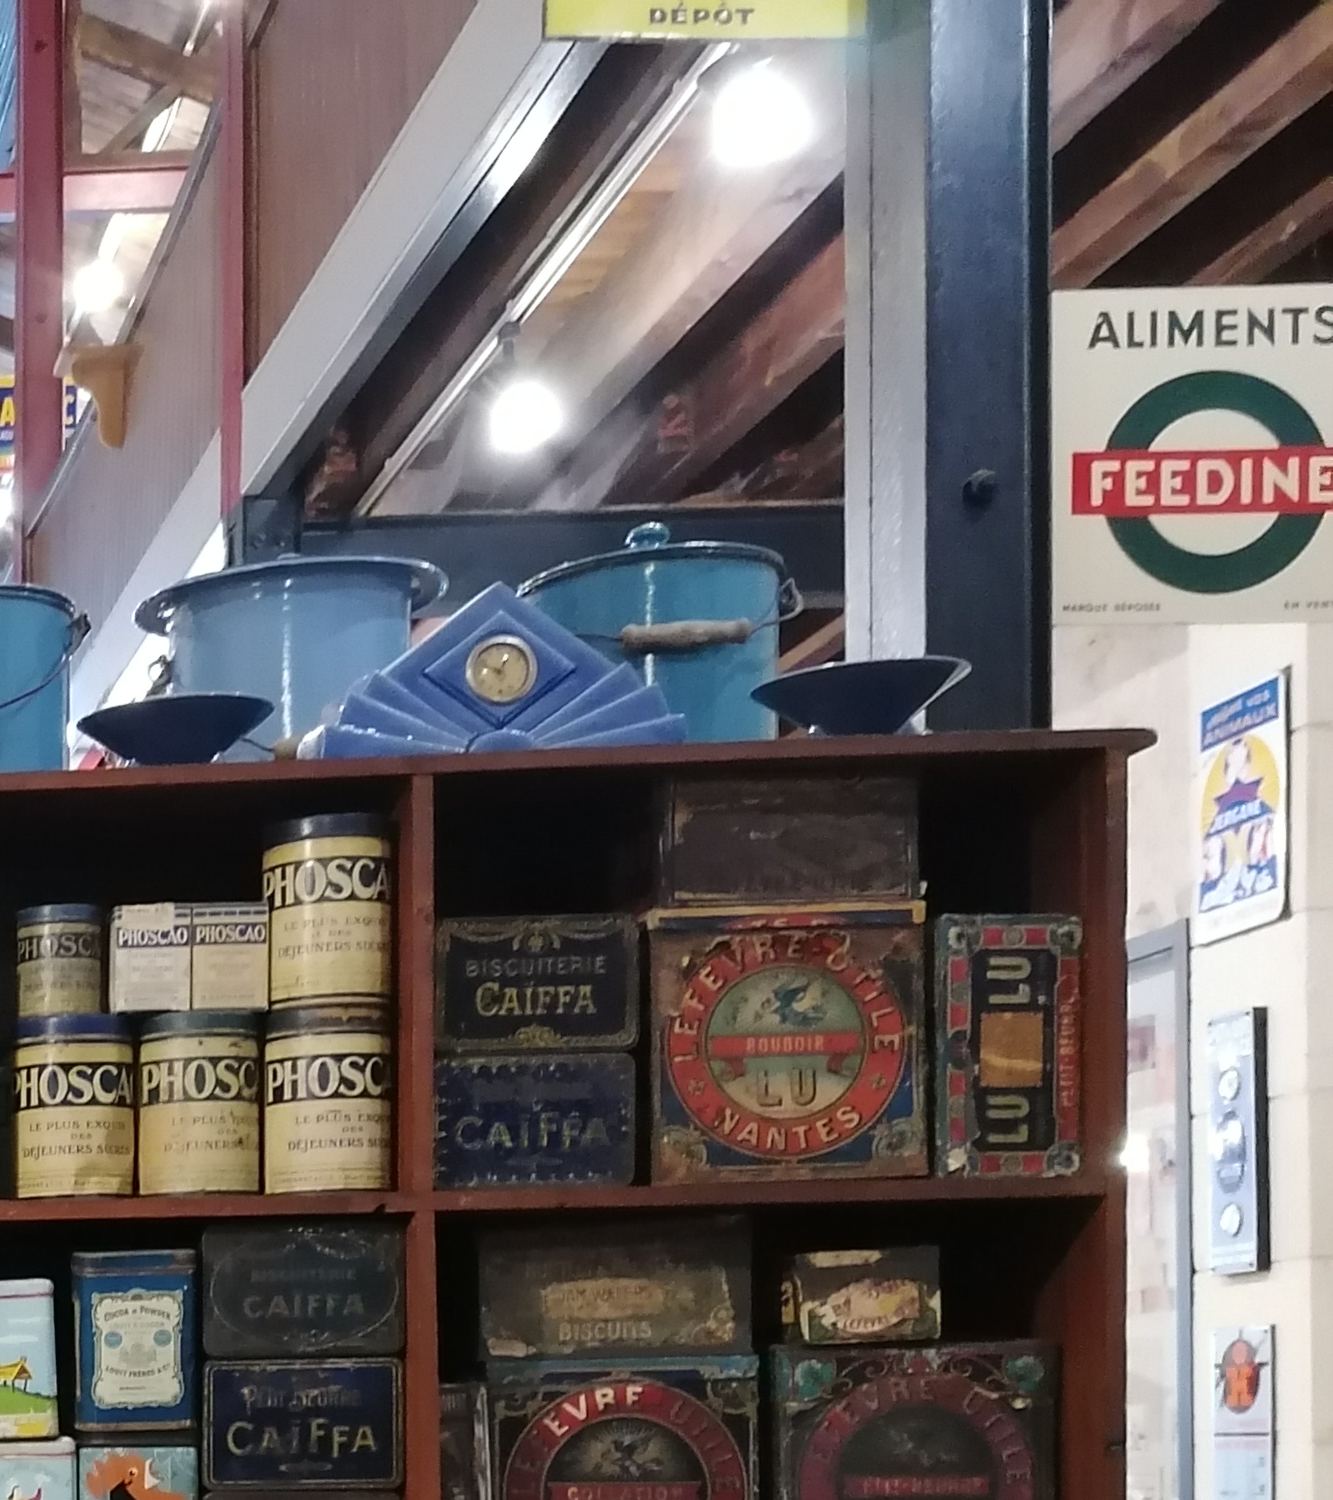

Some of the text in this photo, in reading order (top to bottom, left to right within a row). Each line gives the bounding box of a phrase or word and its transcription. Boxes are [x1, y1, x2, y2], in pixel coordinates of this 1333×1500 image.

[649, 4, 754, 29] DÉPÔT
[1087, 304, 1333, 351] ALIMENTS
[118, 926, 188, 946] PHOSCAO
[195, 923, 266, 943] PHOSCAO
[465, 954, 608, 980] BISCUITERIE
[989, 956, 1032, 1006] LU
[474, 978, 597, 1018] CAÏFFA
[744, 1034, 827, 1054] BOUDOIR
[754, 1066, 818, 1108] LU
[711, 1103, 863, 1158] NANTES
[989, 1094, 1031, 1145] LU
